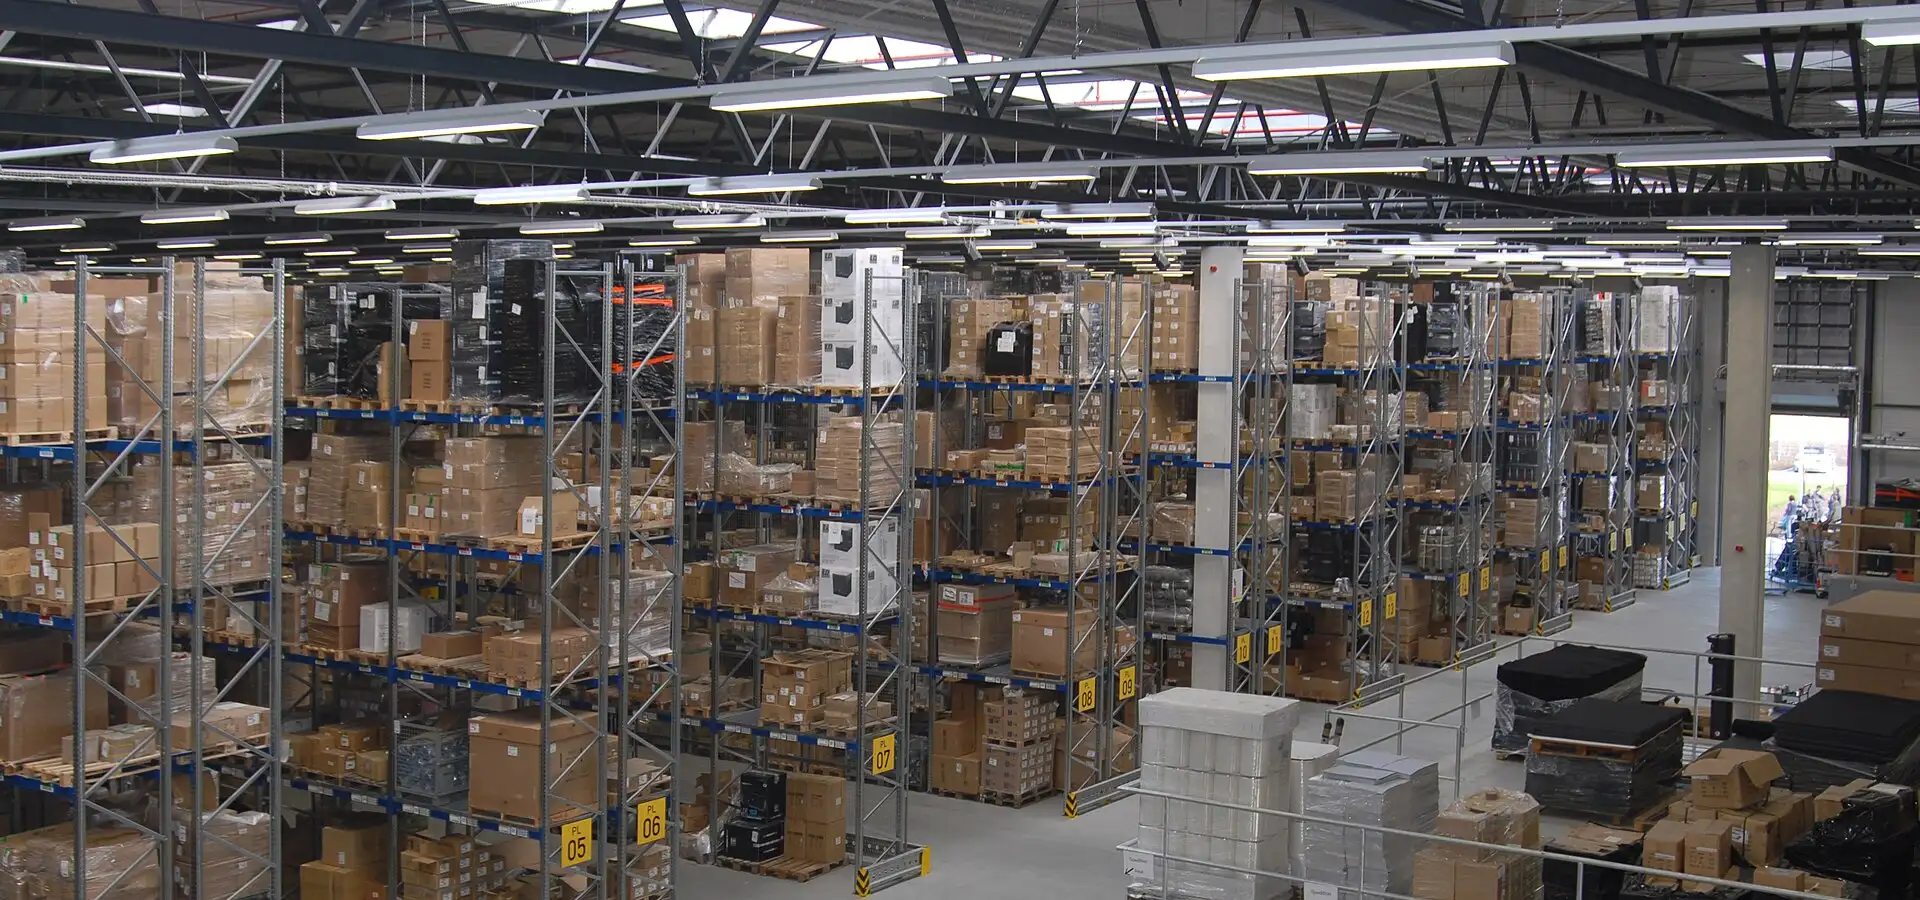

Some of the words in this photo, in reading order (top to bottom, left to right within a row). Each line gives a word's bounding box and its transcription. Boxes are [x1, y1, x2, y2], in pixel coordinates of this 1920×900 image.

[1271, 636, 1279, 650] 11
[1239, 645, 1248, 660] 10
[1122, 679, 1132, 695] 09
[1082, 690, 1092, 708] 08
[880, 740, 887, 748] PL
[877, 750, 890, 769] 07
[647, 805, 656, 814] PL
[571, 826, 581, 836] PL
[643, 816, 660, 838] 06
[567, 836, 586, 861] 05
